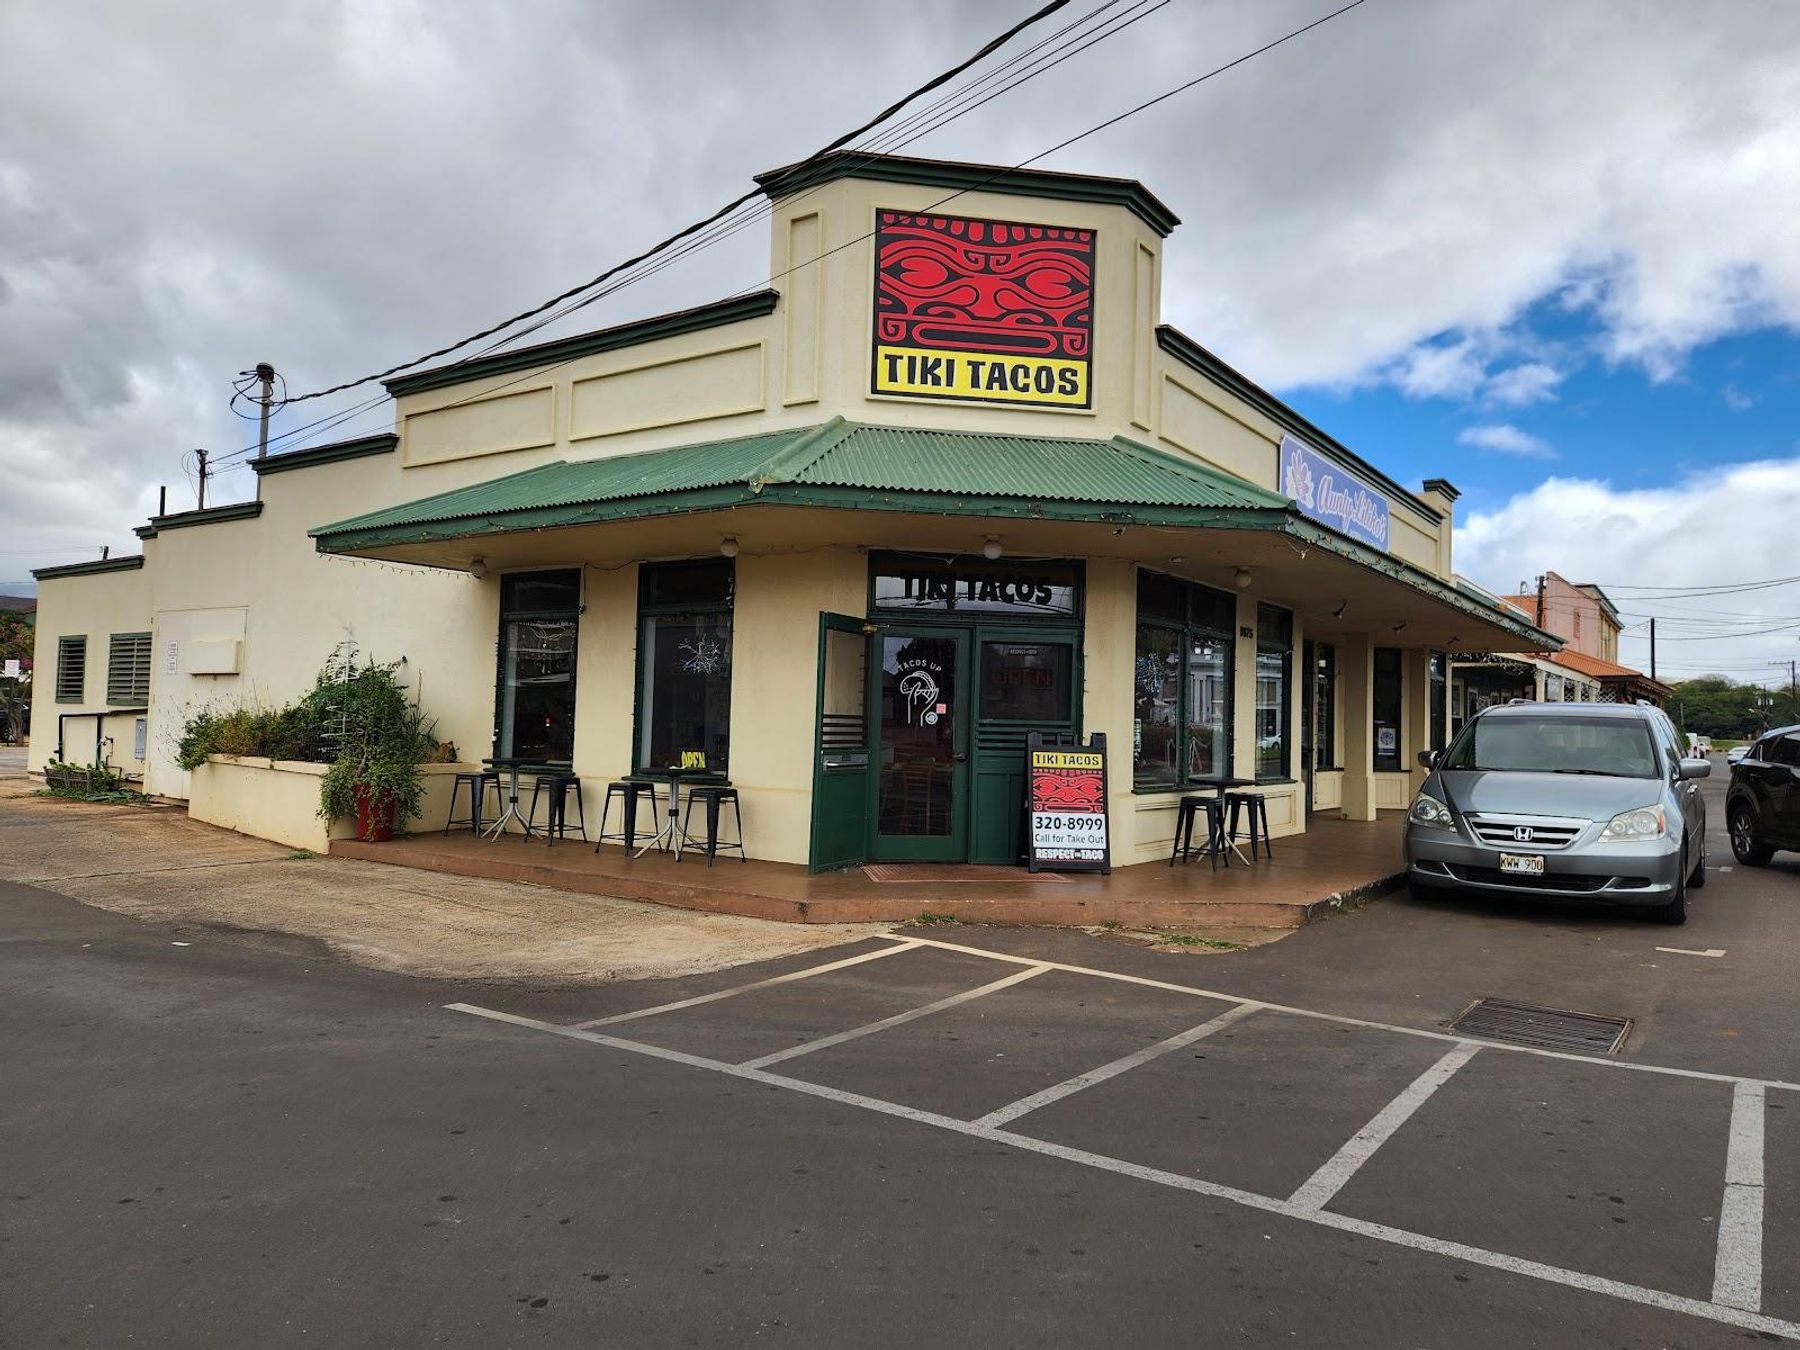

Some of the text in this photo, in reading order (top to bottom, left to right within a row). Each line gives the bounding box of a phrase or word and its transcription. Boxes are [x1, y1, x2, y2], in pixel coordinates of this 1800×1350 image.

[884, 353, 1079, 396] TIKI TACOS
[901, 570, 1052, 605] TIKI TACOS
[898, 659, 942, 672] TACOS UP
[681, 751, 706, 769] OPEN
[1035, 753, 1099, 766] TIKI TACOS
[1035, 816, 1103, 831] 320-8999
[1035, 833, 1104, 844] Call for Take Out
[1035, 848, 1075, 860] RESPECT
[1080, 849, 1104, 860] TACO
[1500, 857, 1520, 869] KWW
